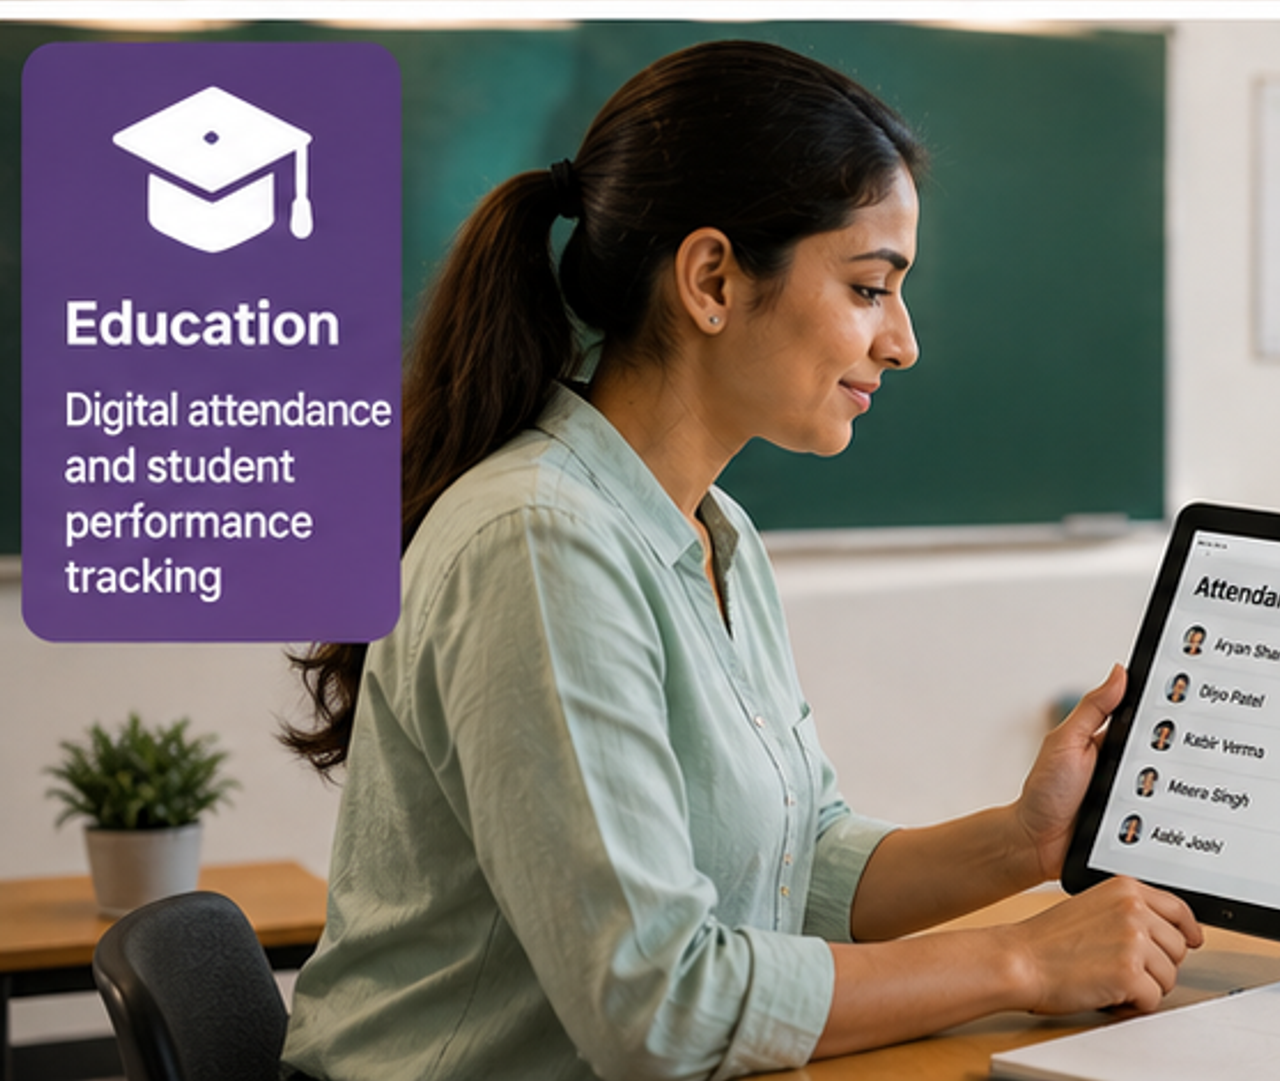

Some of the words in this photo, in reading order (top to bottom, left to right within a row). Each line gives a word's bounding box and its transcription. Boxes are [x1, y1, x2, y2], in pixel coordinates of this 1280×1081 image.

[1230, 689, 1265, 708] Patel
[1168, 779, 1209, 800] Meera
[1211, 787, 1250, 810] Singh
